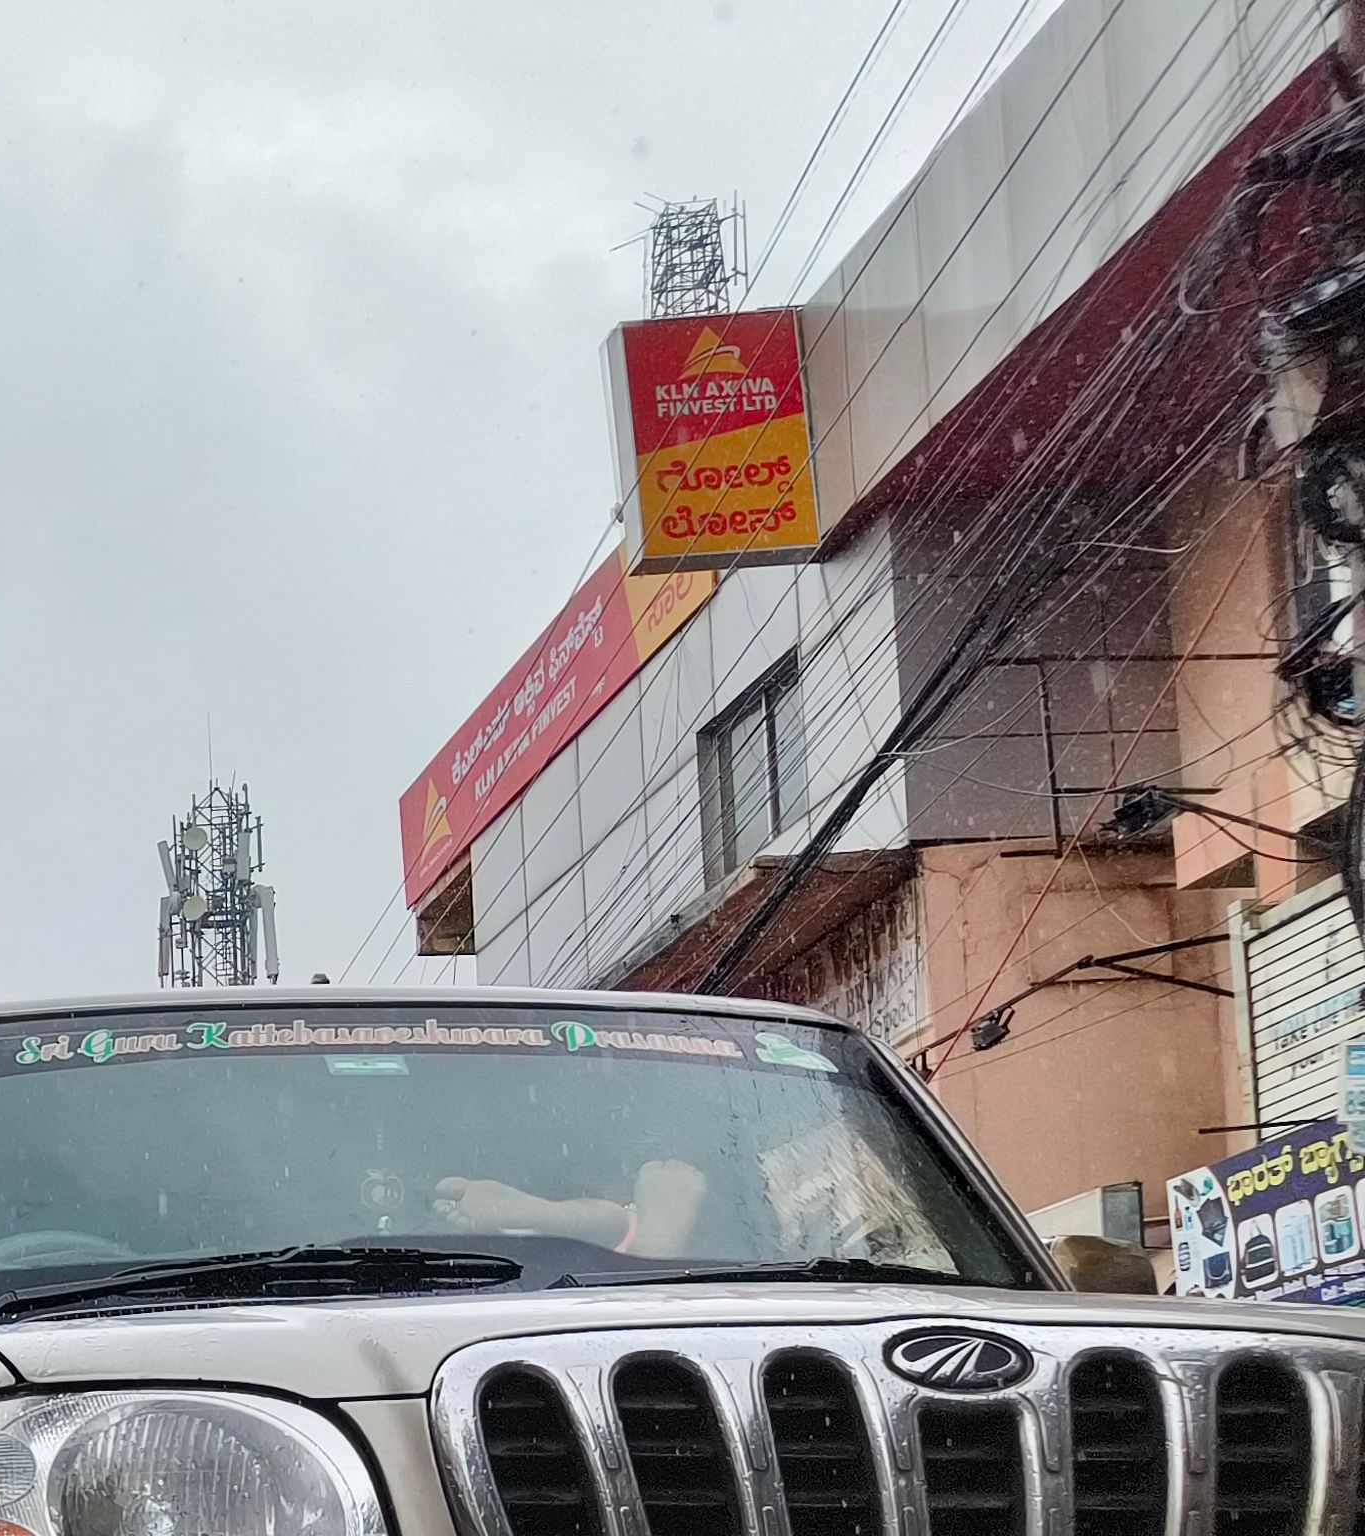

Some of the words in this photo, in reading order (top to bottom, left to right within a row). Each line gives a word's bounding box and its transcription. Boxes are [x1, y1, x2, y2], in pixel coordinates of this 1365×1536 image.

[655, 383, 699, 401] KLM
[657, 398, 737, 417] FINVEST
[742, 394, 778, 411] LTD
[661, 501, 797, 540] ಲೋನ್
[532, 676, 576, 740] FINVEST
[16, 1035, 74, 1064] Sri
[78, 1029, 183, 1063] Guru
[551, 1021, 744, 1058] Prasanna
